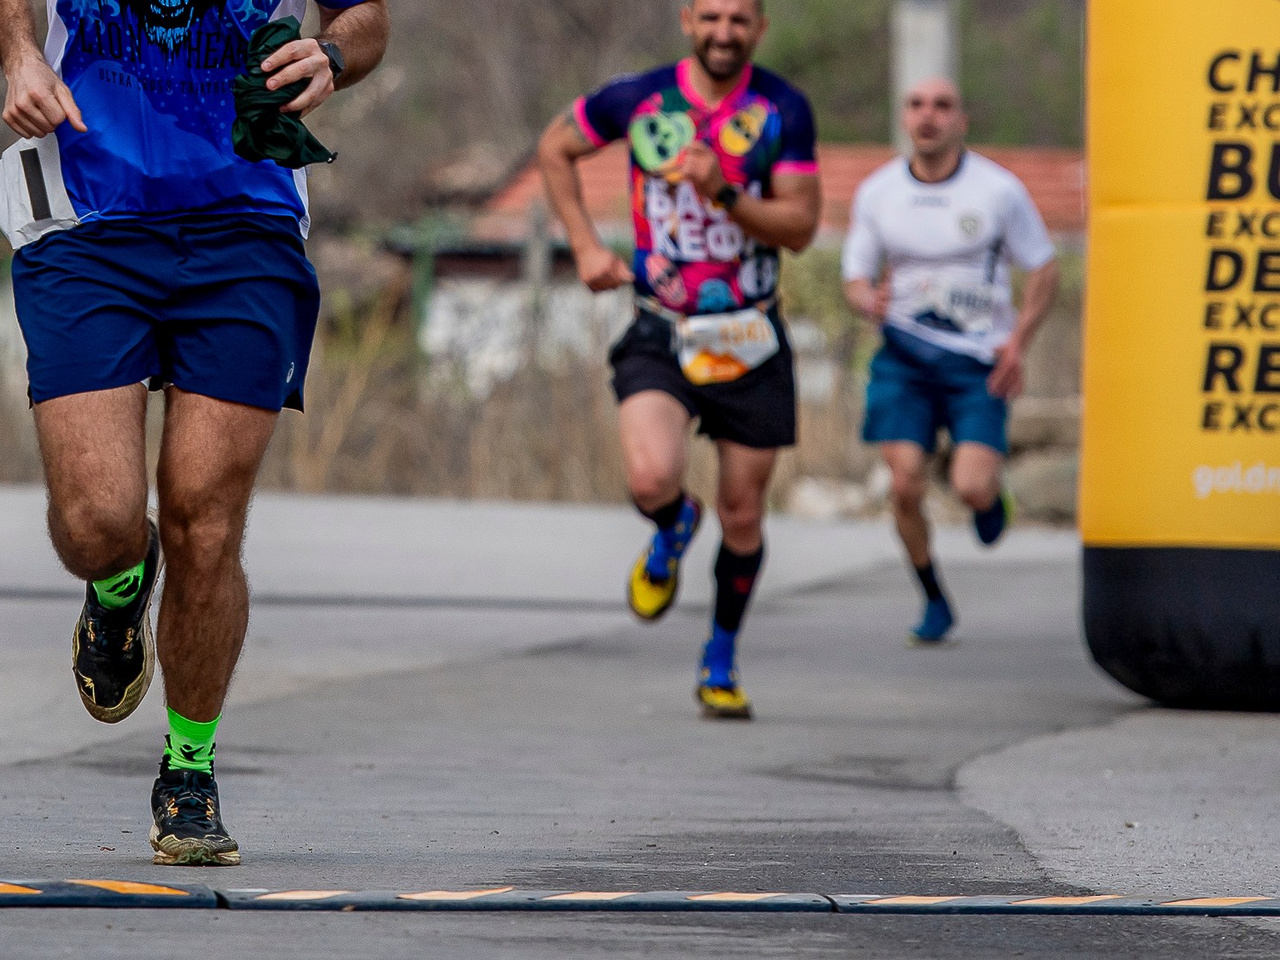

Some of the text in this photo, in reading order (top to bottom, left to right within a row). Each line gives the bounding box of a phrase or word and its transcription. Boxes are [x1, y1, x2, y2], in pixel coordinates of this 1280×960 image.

[80, 17, 140, 62] LION
[98, 67, 132, 88] ULTRA
[1206, 142, 1280, 202] B
